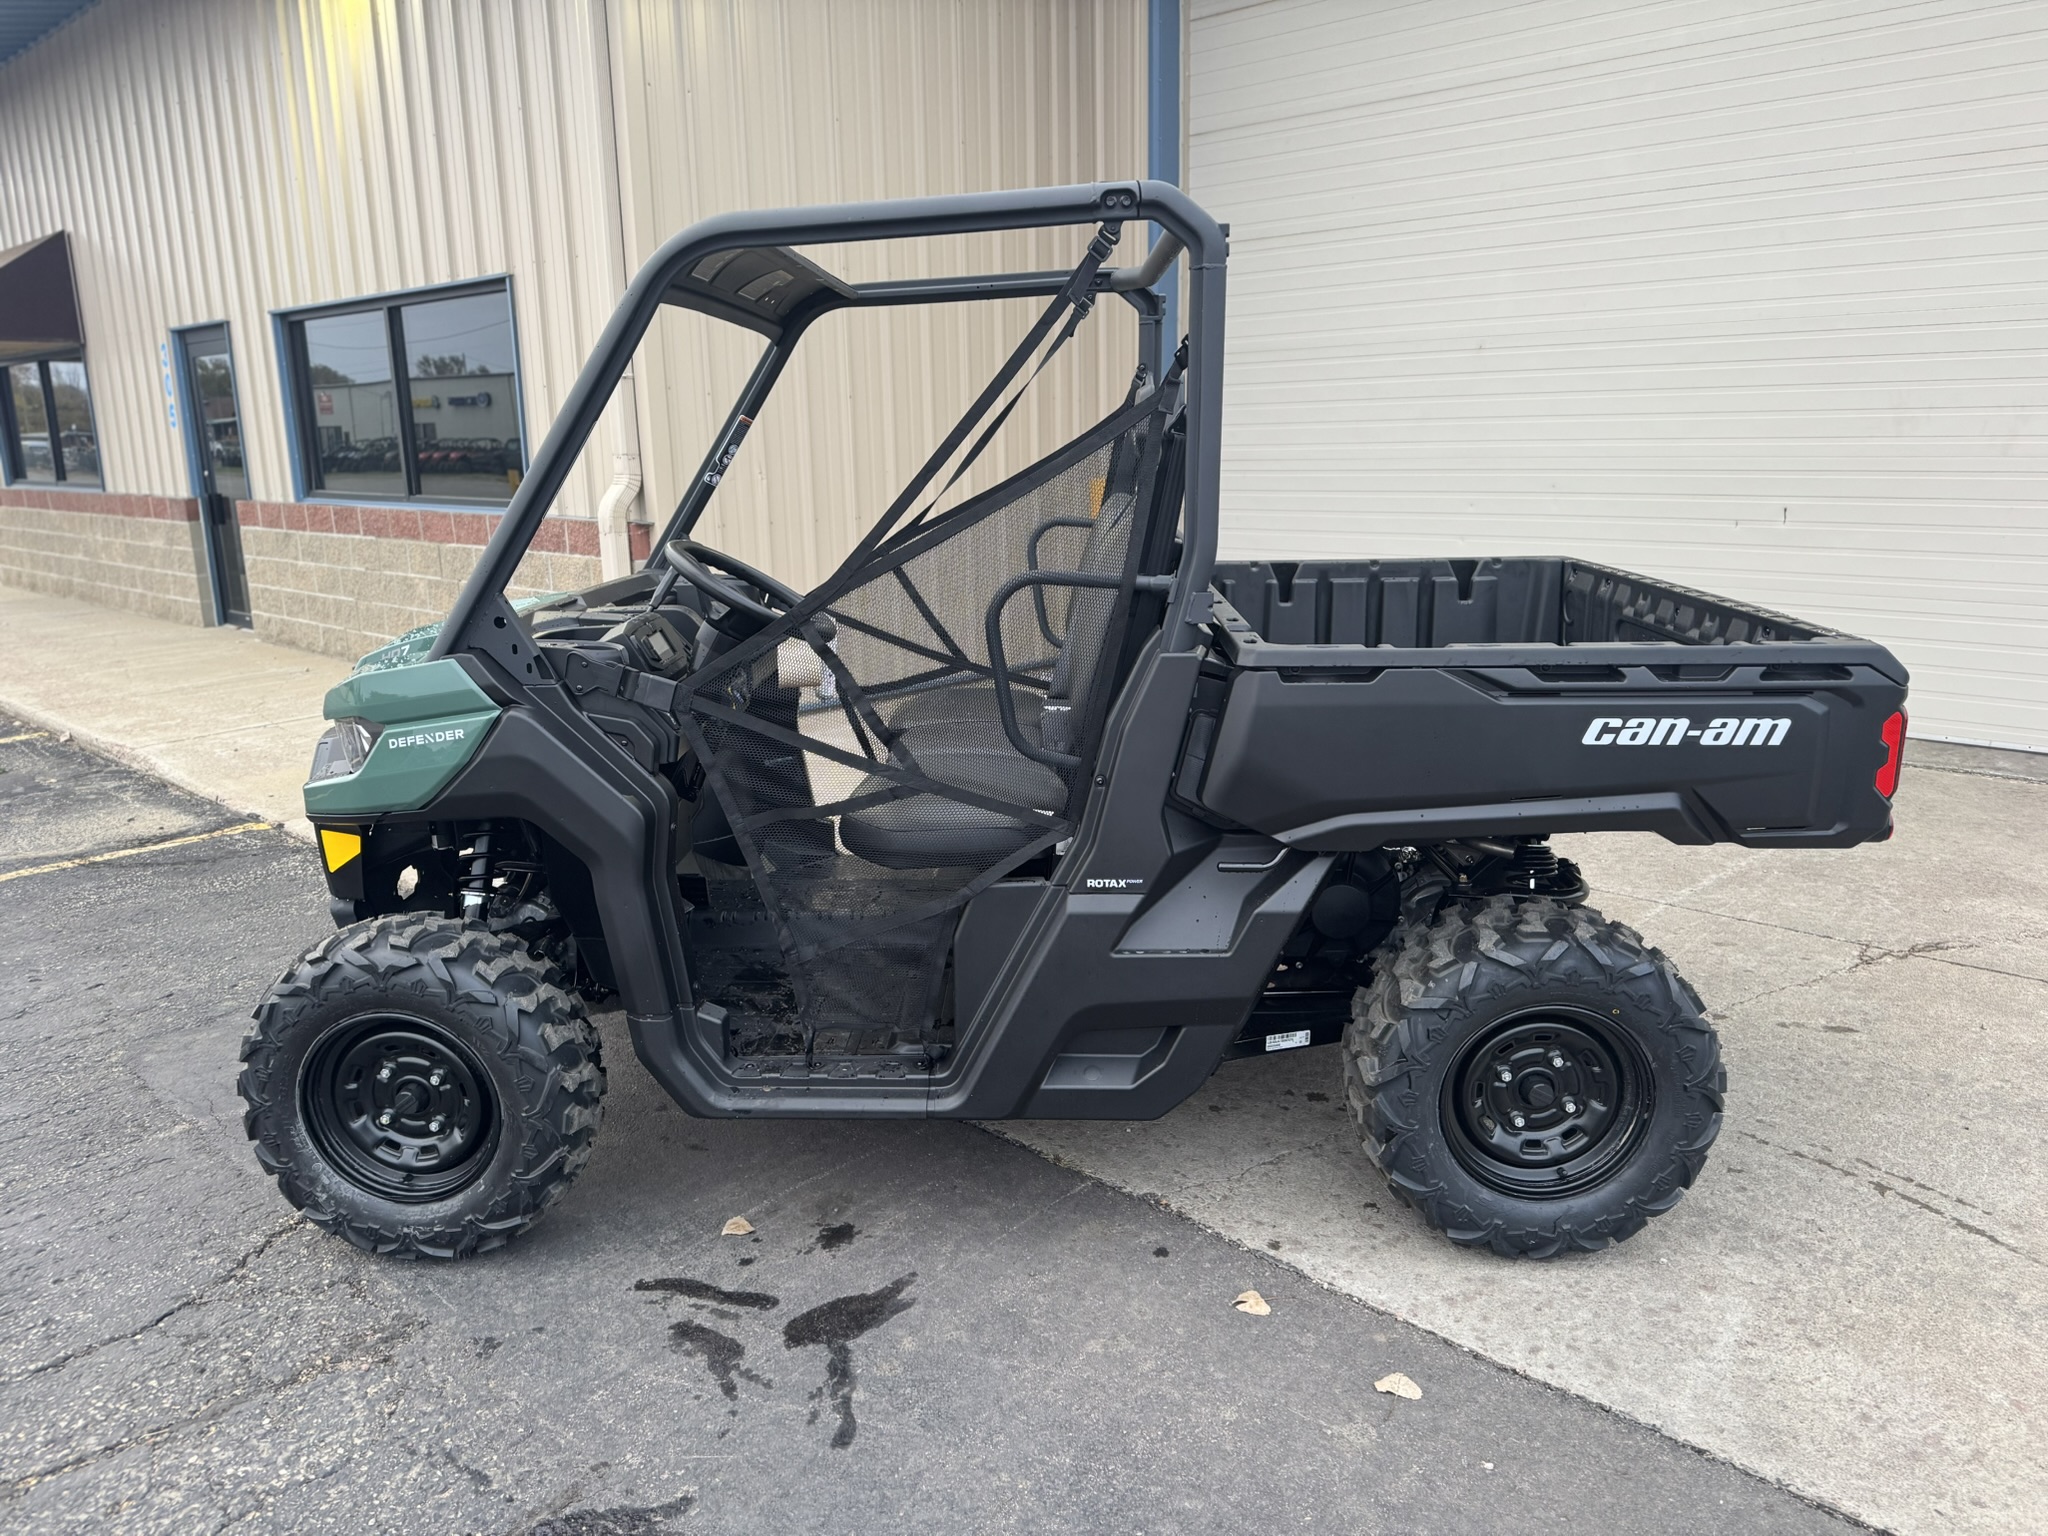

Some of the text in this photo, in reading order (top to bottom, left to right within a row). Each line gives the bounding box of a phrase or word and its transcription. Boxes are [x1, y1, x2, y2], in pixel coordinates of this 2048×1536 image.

[388, 729, 465, 749] DEFENDER
[1582, 717, 1792, 746] can-am
[1086, 879, 1127, 888] ROTAX
